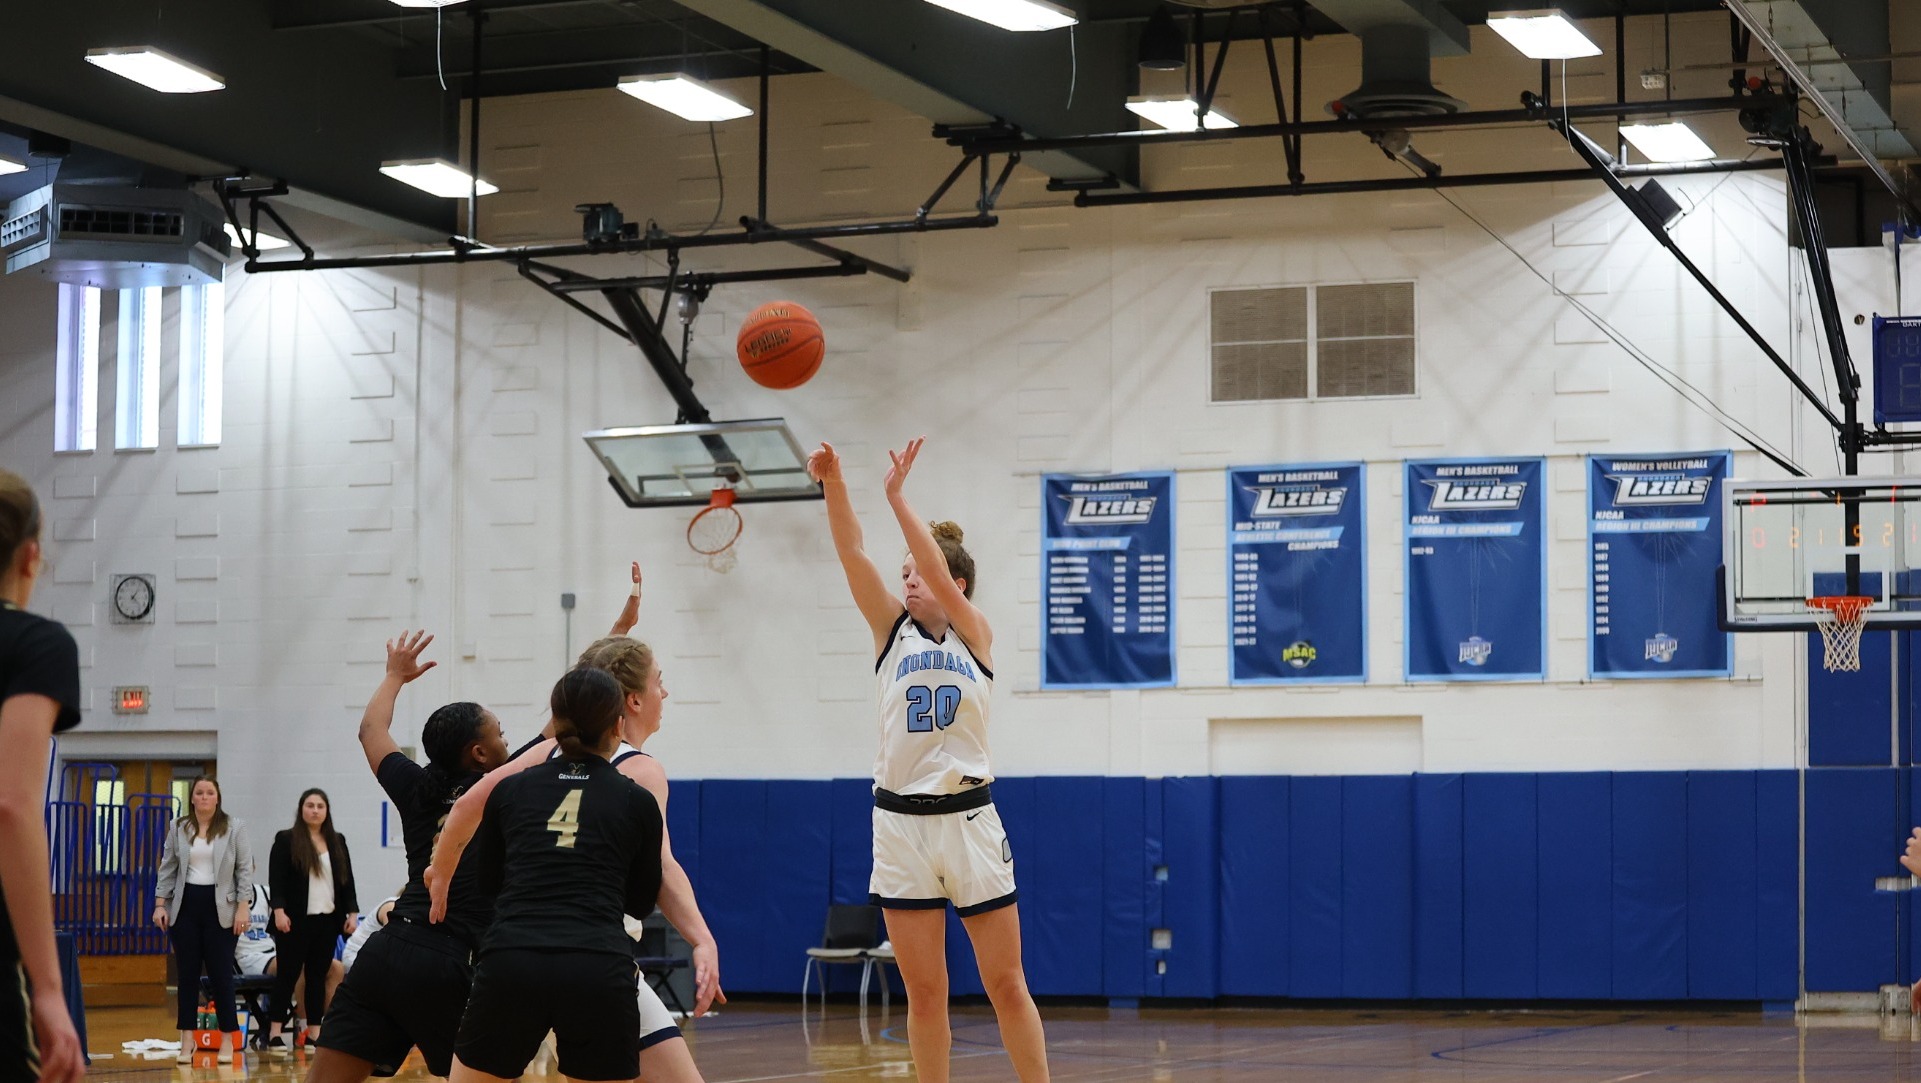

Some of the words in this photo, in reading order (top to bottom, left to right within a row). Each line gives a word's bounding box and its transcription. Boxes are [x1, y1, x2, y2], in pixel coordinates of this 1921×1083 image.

[1436, 466, 1464, 476] MEN'S
[1464, 465, 1519, 476] BASKETBALL
[1612, 462, 1654, 472] WOMEN'S
[1656, 460, 1708, 470] VOLLEYBALL
[1258, 473, 1284, 482] MEN'S
[1285, 471, 1338, 482] BASKETBALL
[1070, 483, 1098, 492] MEN'S
[1098, 480, 1148, 491] BASKETBALL
[1616, 478, 1707, 504] LAZERS
[1432, 482, 1522, 508] LAZERS
[1254, 489, 1343, 514] LAZERS
[1068, 498, 1152, 522] LAZERS
[1596, 510, 1624, 520] NJCAA
[1235, 522, 1281, 530] MID-STATE
[1458, 524, 1512, 534] CHAMPIONS
[1642, 520, 1698, 530] CHAMPIONS
[1288, 540, 1339, 551] CHAMPIONS
[1282, 647, 1316, 662] MSAC
[906, 685, 961, 732] 20
[547, 788, 583, 848] 4
[202, 1032, 210, 1046] G
